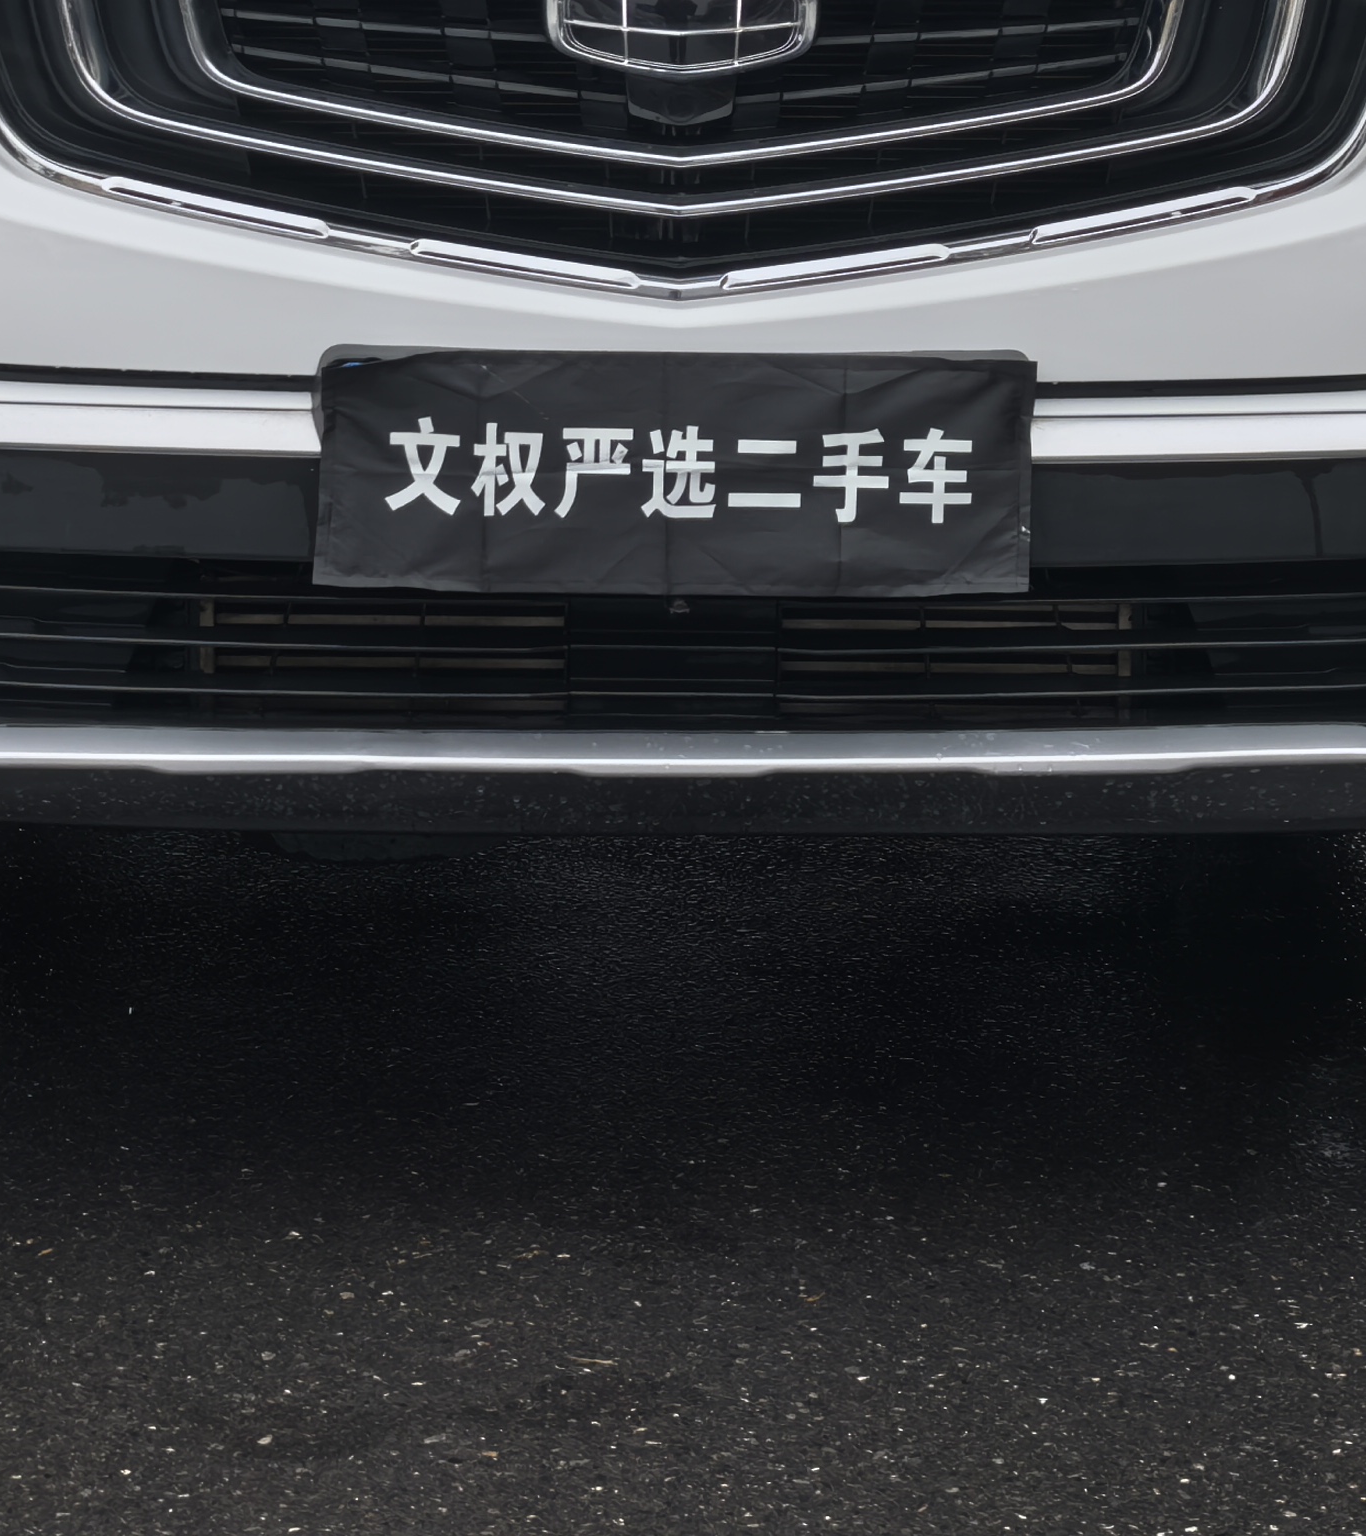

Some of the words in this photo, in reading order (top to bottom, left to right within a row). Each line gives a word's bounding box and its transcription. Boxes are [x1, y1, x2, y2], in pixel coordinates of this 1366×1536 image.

[385, 417, 974, 524] 文权严选二手车
